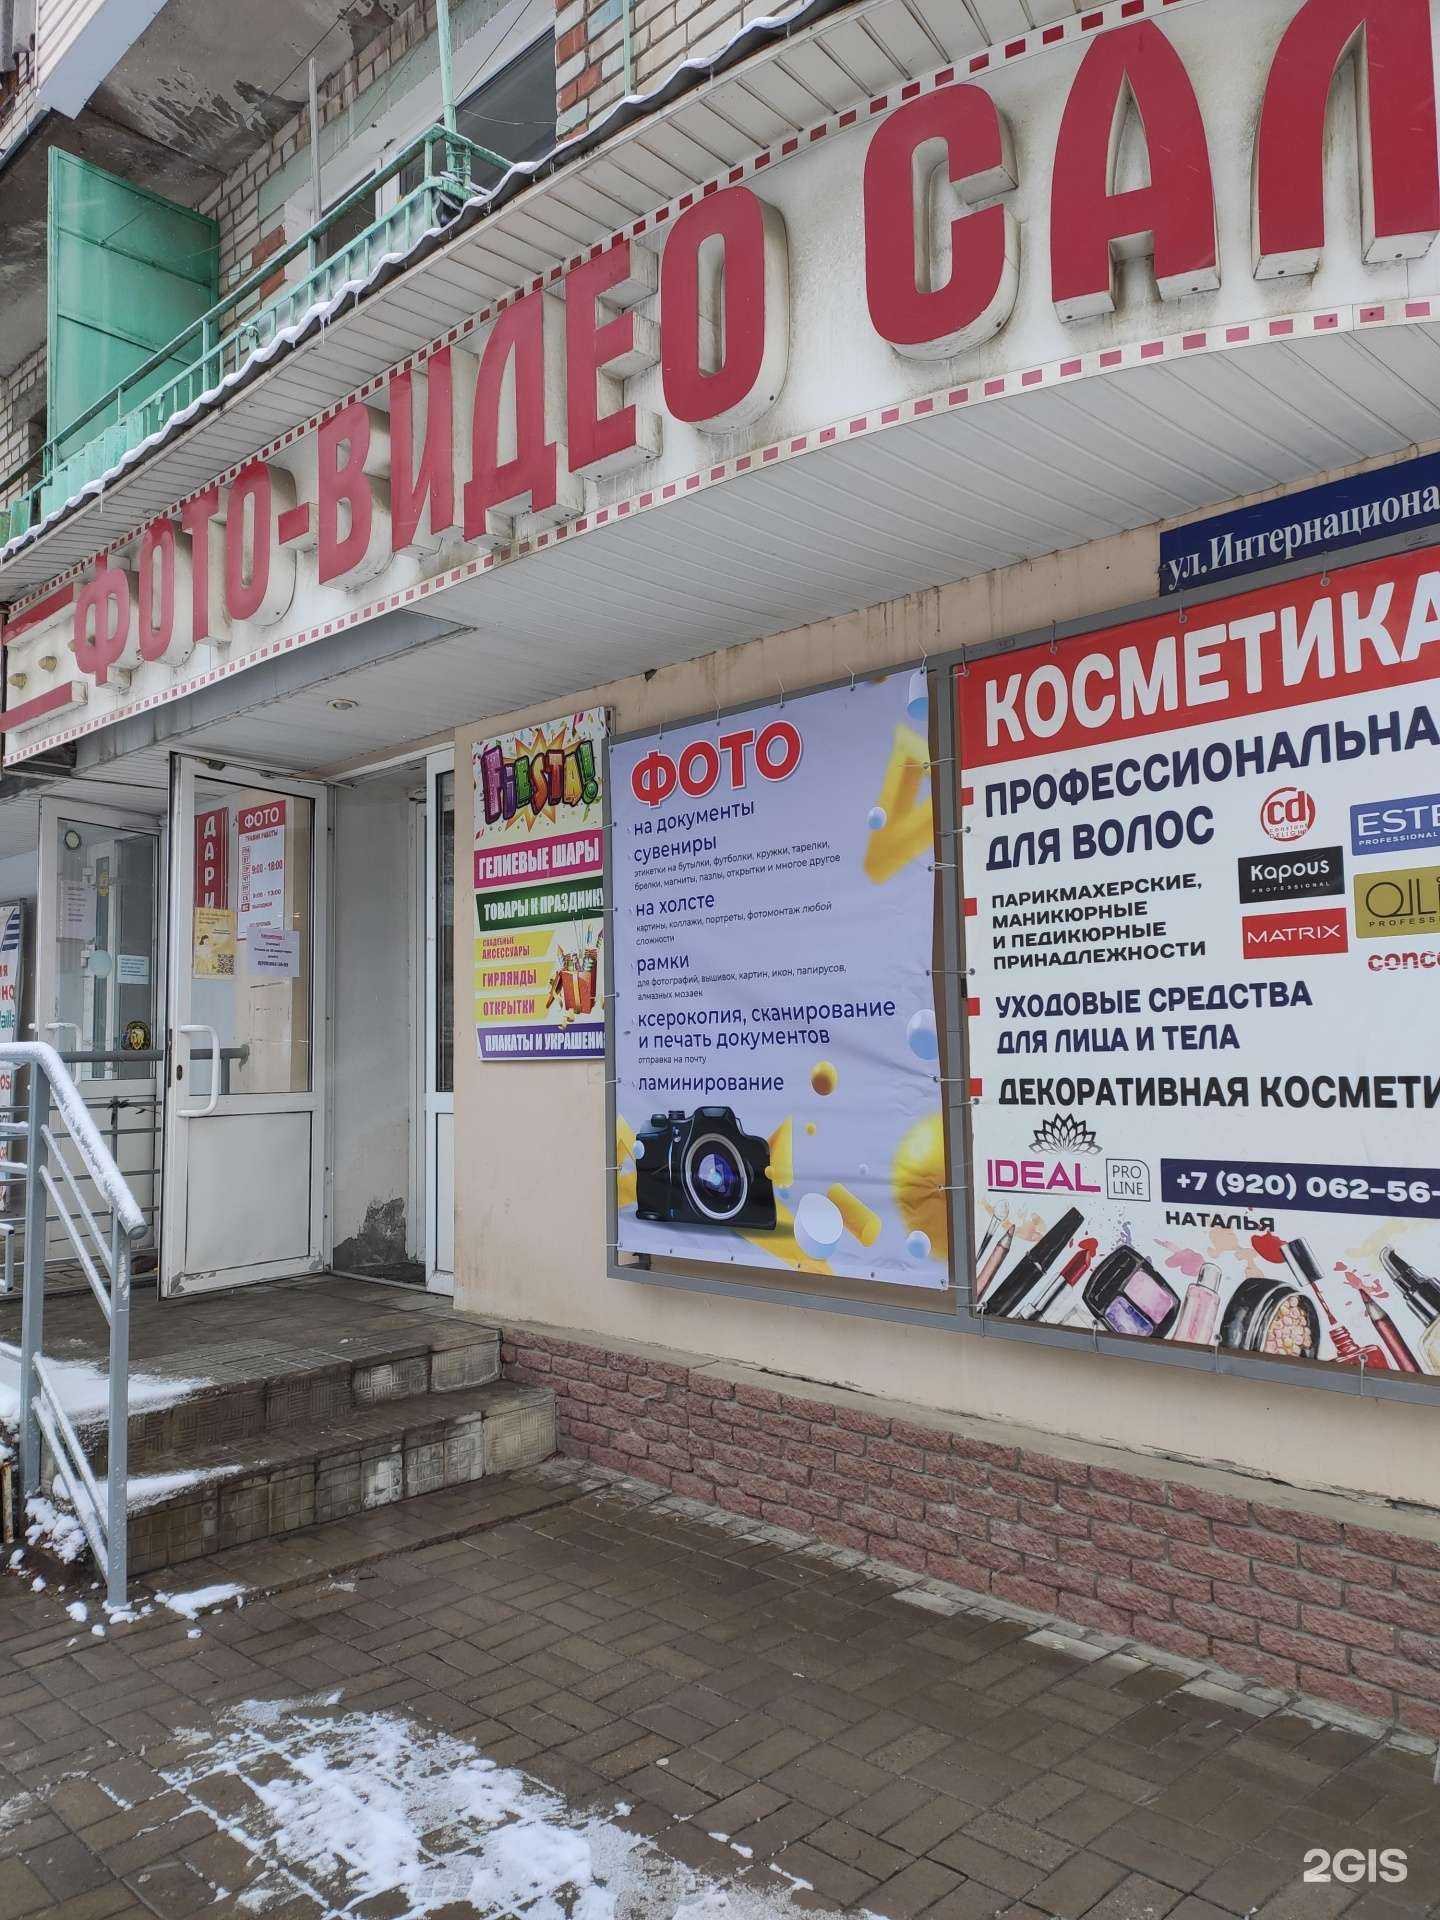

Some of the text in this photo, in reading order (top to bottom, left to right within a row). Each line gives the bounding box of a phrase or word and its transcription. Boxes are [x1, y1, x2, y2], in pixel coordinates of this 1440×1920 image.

[74, 0, 1440, 690] ФОТО-ВИДЕО САЛ
[984, 570, 1440, 748] КОСМЕТИКА
[630, 720, 802, 808] ФОТО
[985, 705, 1440, 818] ПРОФЕССИОНАЛЬНА
[244, 807, 279, 828] ФОТО
[634, 801, 754, 836] на документы
[1268, 791, 1305, 825] cd
[634, 836, 716, 865] сувениры
[985, 805, 1215, 871] ДЛЯ ВОЛОС
[1358, 832, 1438, 846] PROFESSIONAL
[479, 838, 599, 880] ГЕЛИЕВЫЕ ШАРЫ
[634, 840, 830, 878] этикетки на бутылки, футболки, кружки, тарелки,
[1250, 859, 1330, 883] Kapous
[634, 881, 662, 891] брелки,
[664, 875, 698, 887] магниты,
[727, 865, 766, 879] открытки
[767, 864, 774, 872] и
[775, 859, 808, 871] многое
[809, 854, 841, 867] другое
[991, 872, 1203, 909] ПАРИКМАХЕРСКИЕ,
[1251, 881, 1330, 893] PROFESSIONAL
[484, 899, 529, 921] ТОВАРЫ
[530, 896, 539, 915] К
[636, 893, 715, 917] на холсте
[705, 911, 745, 924] портреты,
[747, 906, 800, 921] фотомонтаж
[802, 901, 832, 914] любой
[992, 901, 1148, 930] МАНИКЮРНЫЕ
[636, 935, 675, 945] сложности
[993, 922, 1167, 950] И ПЕДИКЮРНЫЕ
[1247, 924, 1341, 944] MATRIX
[482, 946, 530, 960] АКСЕССУАРЫ
[637, 955, 690, 976] рамки
[993, 941, 1206, 971] ПРИНАДЛЕЖНОСТИ
[483, 969, 537, 987] ГИРЛЯНДЫ
[739, 969, 770, 981] картин,
[771, 966, 795, 977] икон,
[796, 963, 847, 976] папирусов,
[674, 989, 703, 998] мозаек
[995, 980, 1313, 1019] УХОДОВЫЕ СРЕДСТВА
[483, 1000, 535, 1016] ОТКРЫТКИ
[638, 1000, 896, 1030] ксерокопия, сканирование
[485, 1031, 605, 1051] ПЛАКАТЫ И УКРАШЕНИ
[639, 1028, 830, 1050] и печать документов
[997, 1024, 1240, 1054] ДЛЯ ЛИЦА И ТЕЛА
[638, 1055, 707, 1065] отправка на почту
[638, 1075, 784, 1095] ламинирование
[999, 1075, 1440, 1109] ДЕКОРАТИВНАЯ КОСМЕТИ
[987, 1159, 1101, 1193] IDEAL
[1112, 1164, 1142, 1180] PRO
[1112, 1180, 1144, 1197] LINE
[1176, 1171, 1208, 1191] +7
[1216, 1170, 1297, 1201] (920)
[1166, 1210, 1275, 1233] НАТАЛЬЯ
